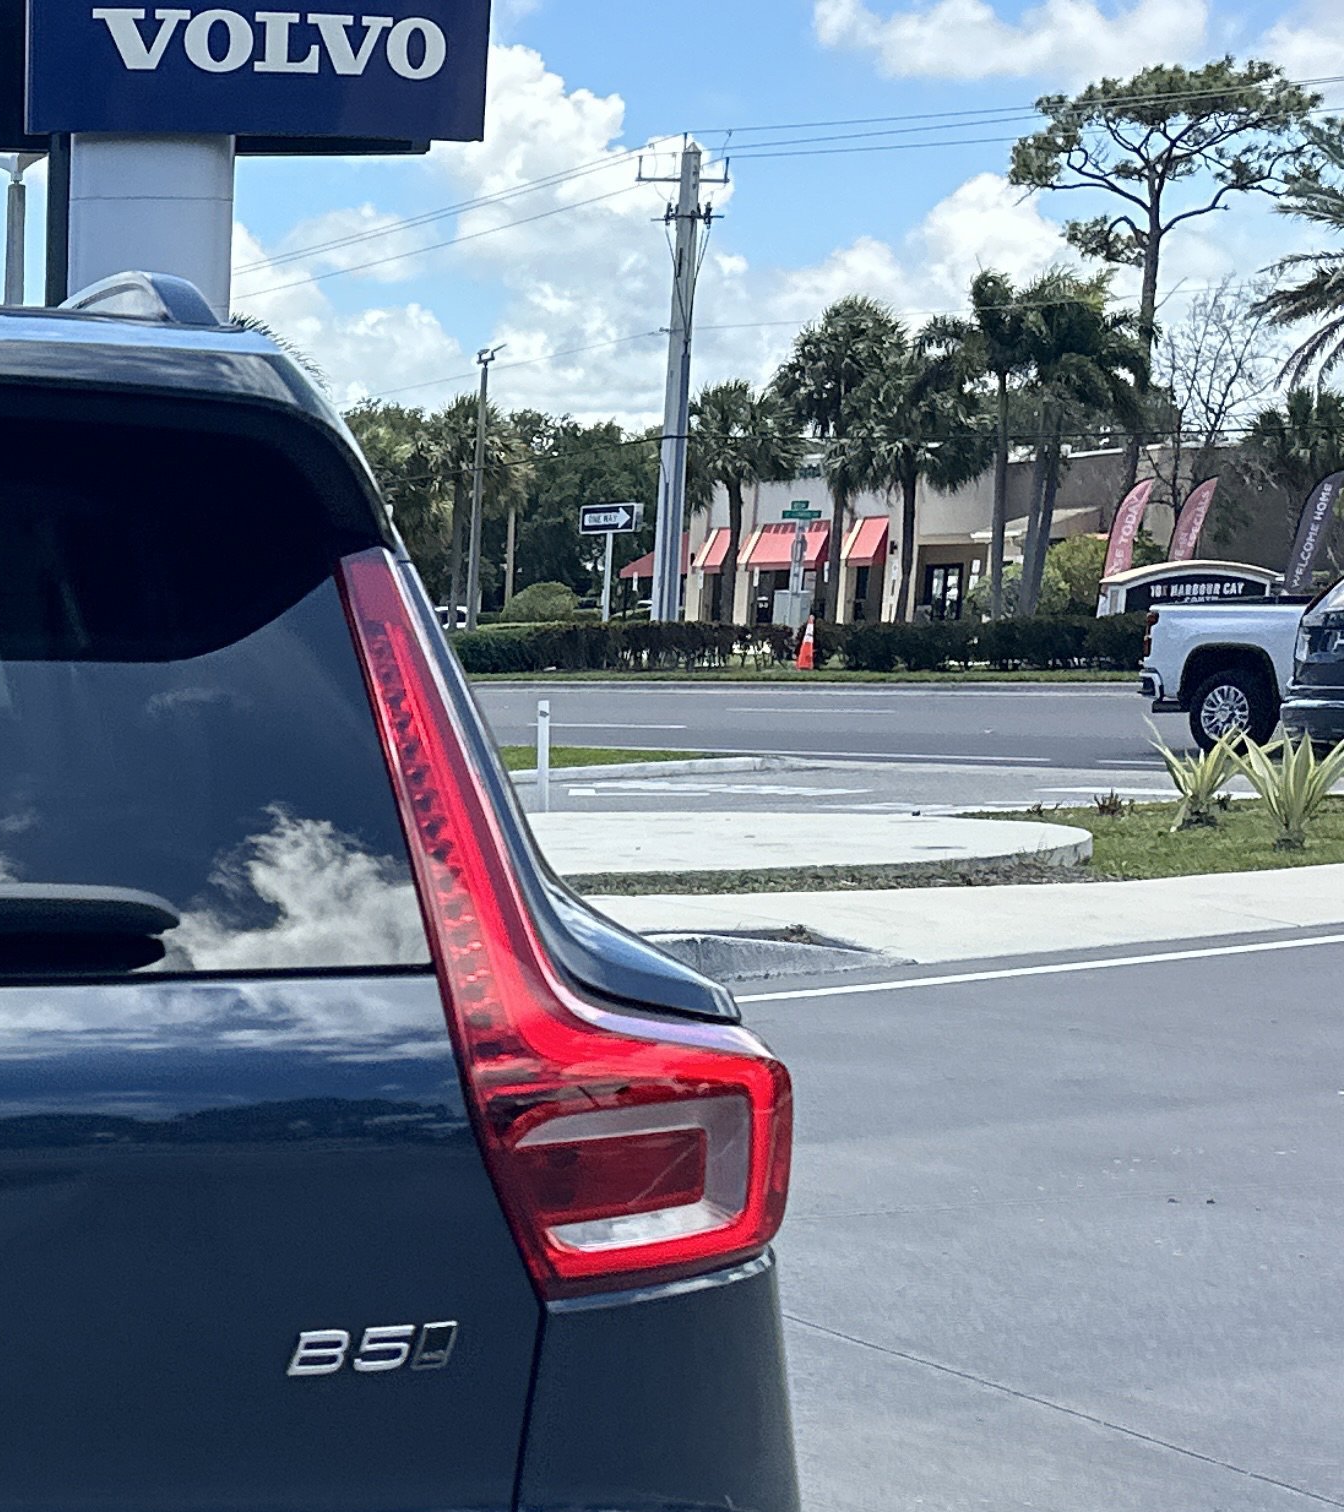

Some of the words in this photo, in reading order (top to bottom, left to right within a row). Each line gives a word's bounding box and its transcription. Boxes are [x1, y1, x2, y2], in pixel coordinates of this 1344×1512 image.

[92, 8, 446, 80] VOLVO
[1292, 523, 1320, 588] WELCOME
[1313, 483, 1332, 520] HOME
